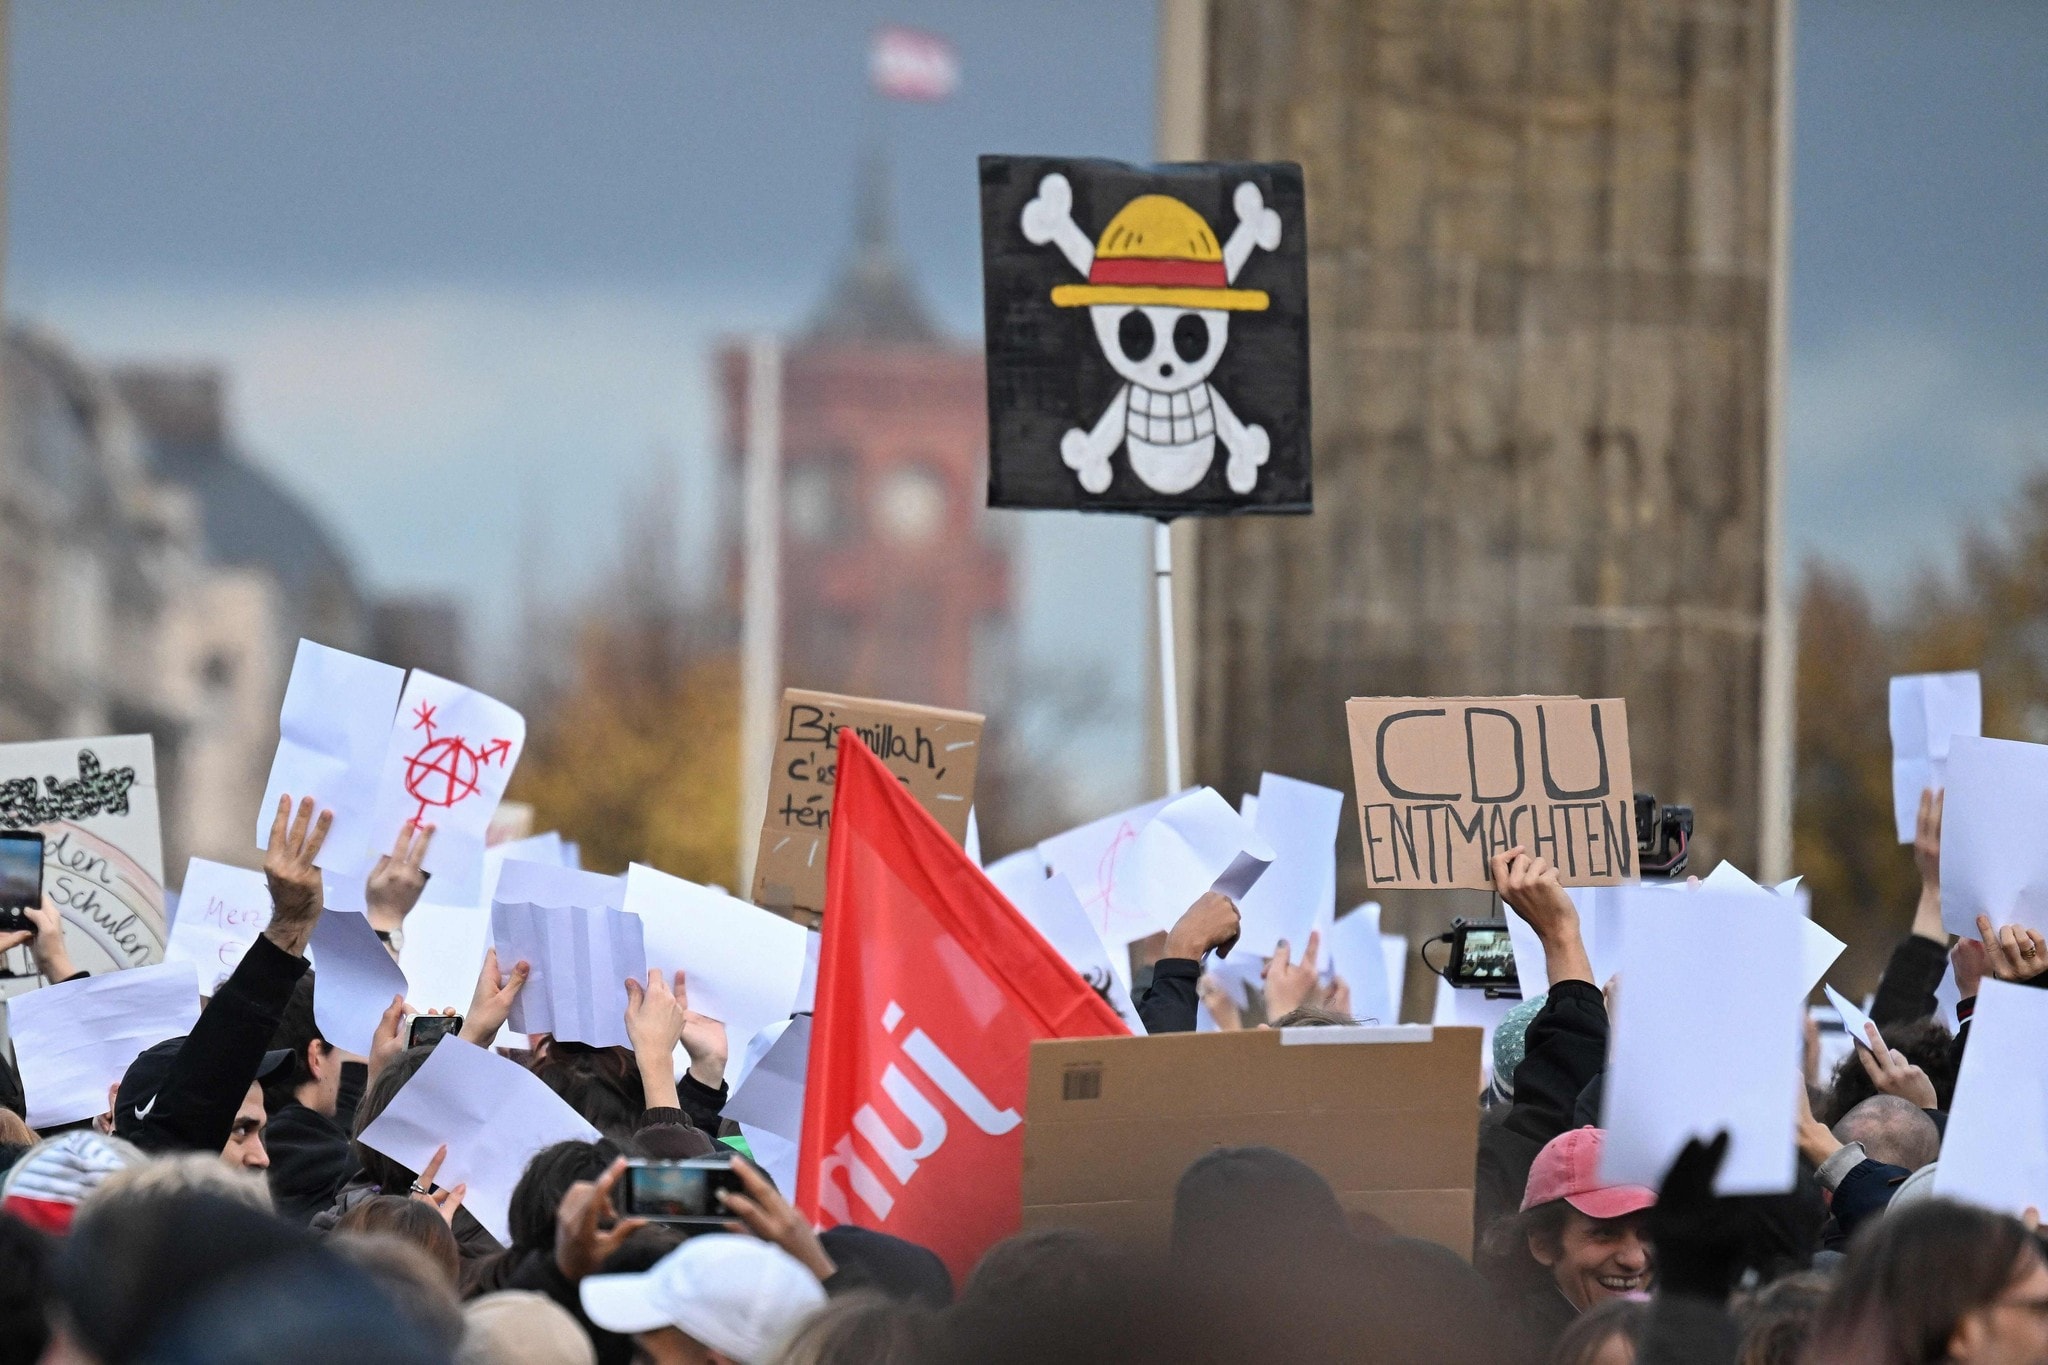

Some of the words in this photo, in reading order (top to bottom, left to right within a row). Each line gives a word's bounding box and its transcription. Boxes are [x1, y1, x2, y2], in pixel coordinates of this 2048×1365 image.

[1376, 703, 1610, 804] CDU
[779, 792, 832, 830] tén
[1364, 800, 1632, 884] ENTMACHTEN
